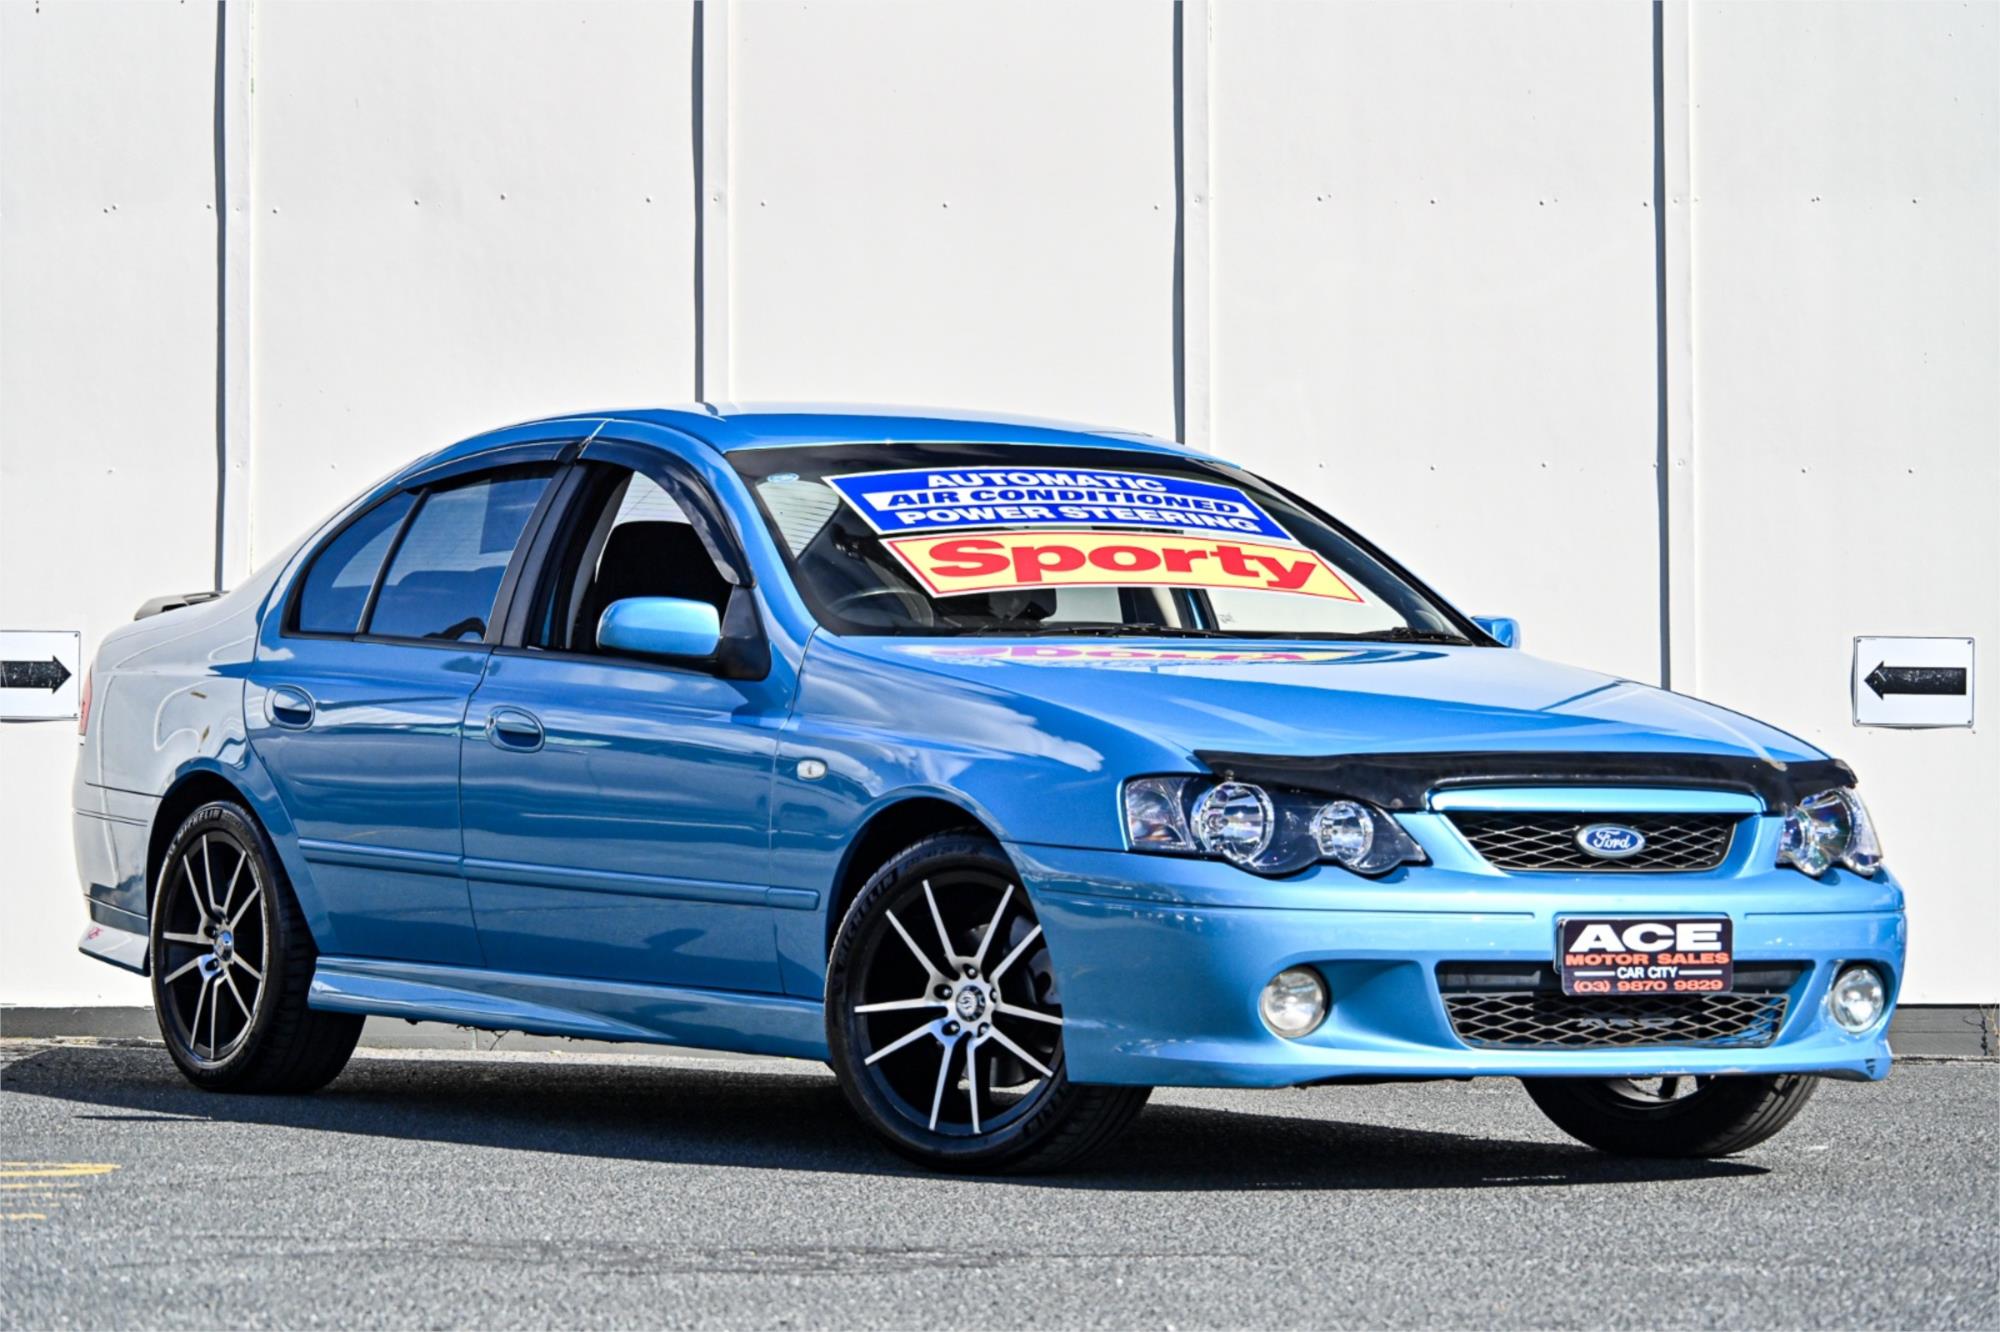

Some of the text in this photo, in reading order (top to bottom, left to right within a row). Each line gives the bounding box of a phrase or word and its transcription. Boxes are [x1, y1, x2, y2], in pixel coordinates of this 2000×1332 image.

[928, 471, 1167, 493] AUTOMATIC
[888, 488, 1242, 515] AIR CONDITIONED
[897, 505, 1262, 532] POWER STEERING
[930, 539, 1317, 589] Sporty
[1593, 830, 1631, 849] Ford
[1569, 923, 1722, 953] ACE
[1566, 953, 1730, 966] MOTOR SALES
[1617, 966, 1678, 979] CAR CITY
[1574, 980, 1723, 993] (03) 9870 9829
